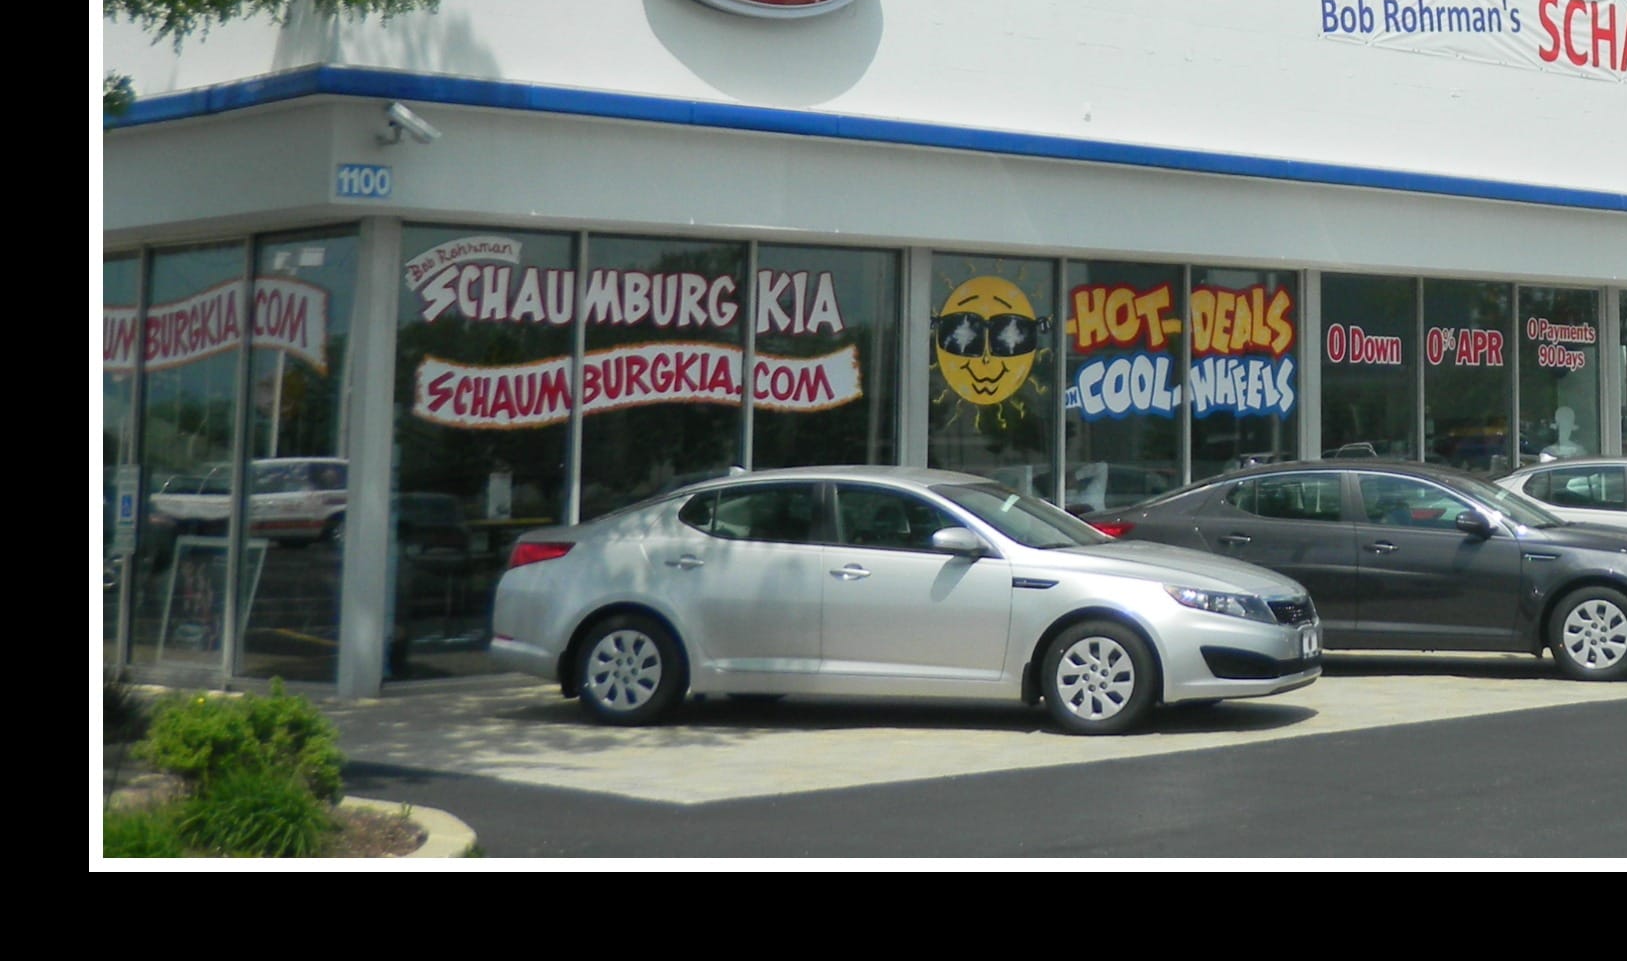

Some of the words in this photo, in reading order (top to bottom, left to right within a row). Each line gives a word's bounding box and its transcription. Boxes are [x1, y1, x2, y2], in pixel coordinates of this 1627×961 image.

[339, 167, 390, 195] 1100
[409, 259, 435, 282] Bob
[422, 265, 739, 328] SCHAUMBURG
[756, 269, 845, 334] KIA
[1350, 326, 1401, 364] Down
[1456, 328, 1503, 366] APR
[1539, 318, 1596, 343] Payments
[1538, 347, 1556, 366] 90
[1556, 347, 1585, 371] Days
[1191, 356, 1295, 414] WHEELS
